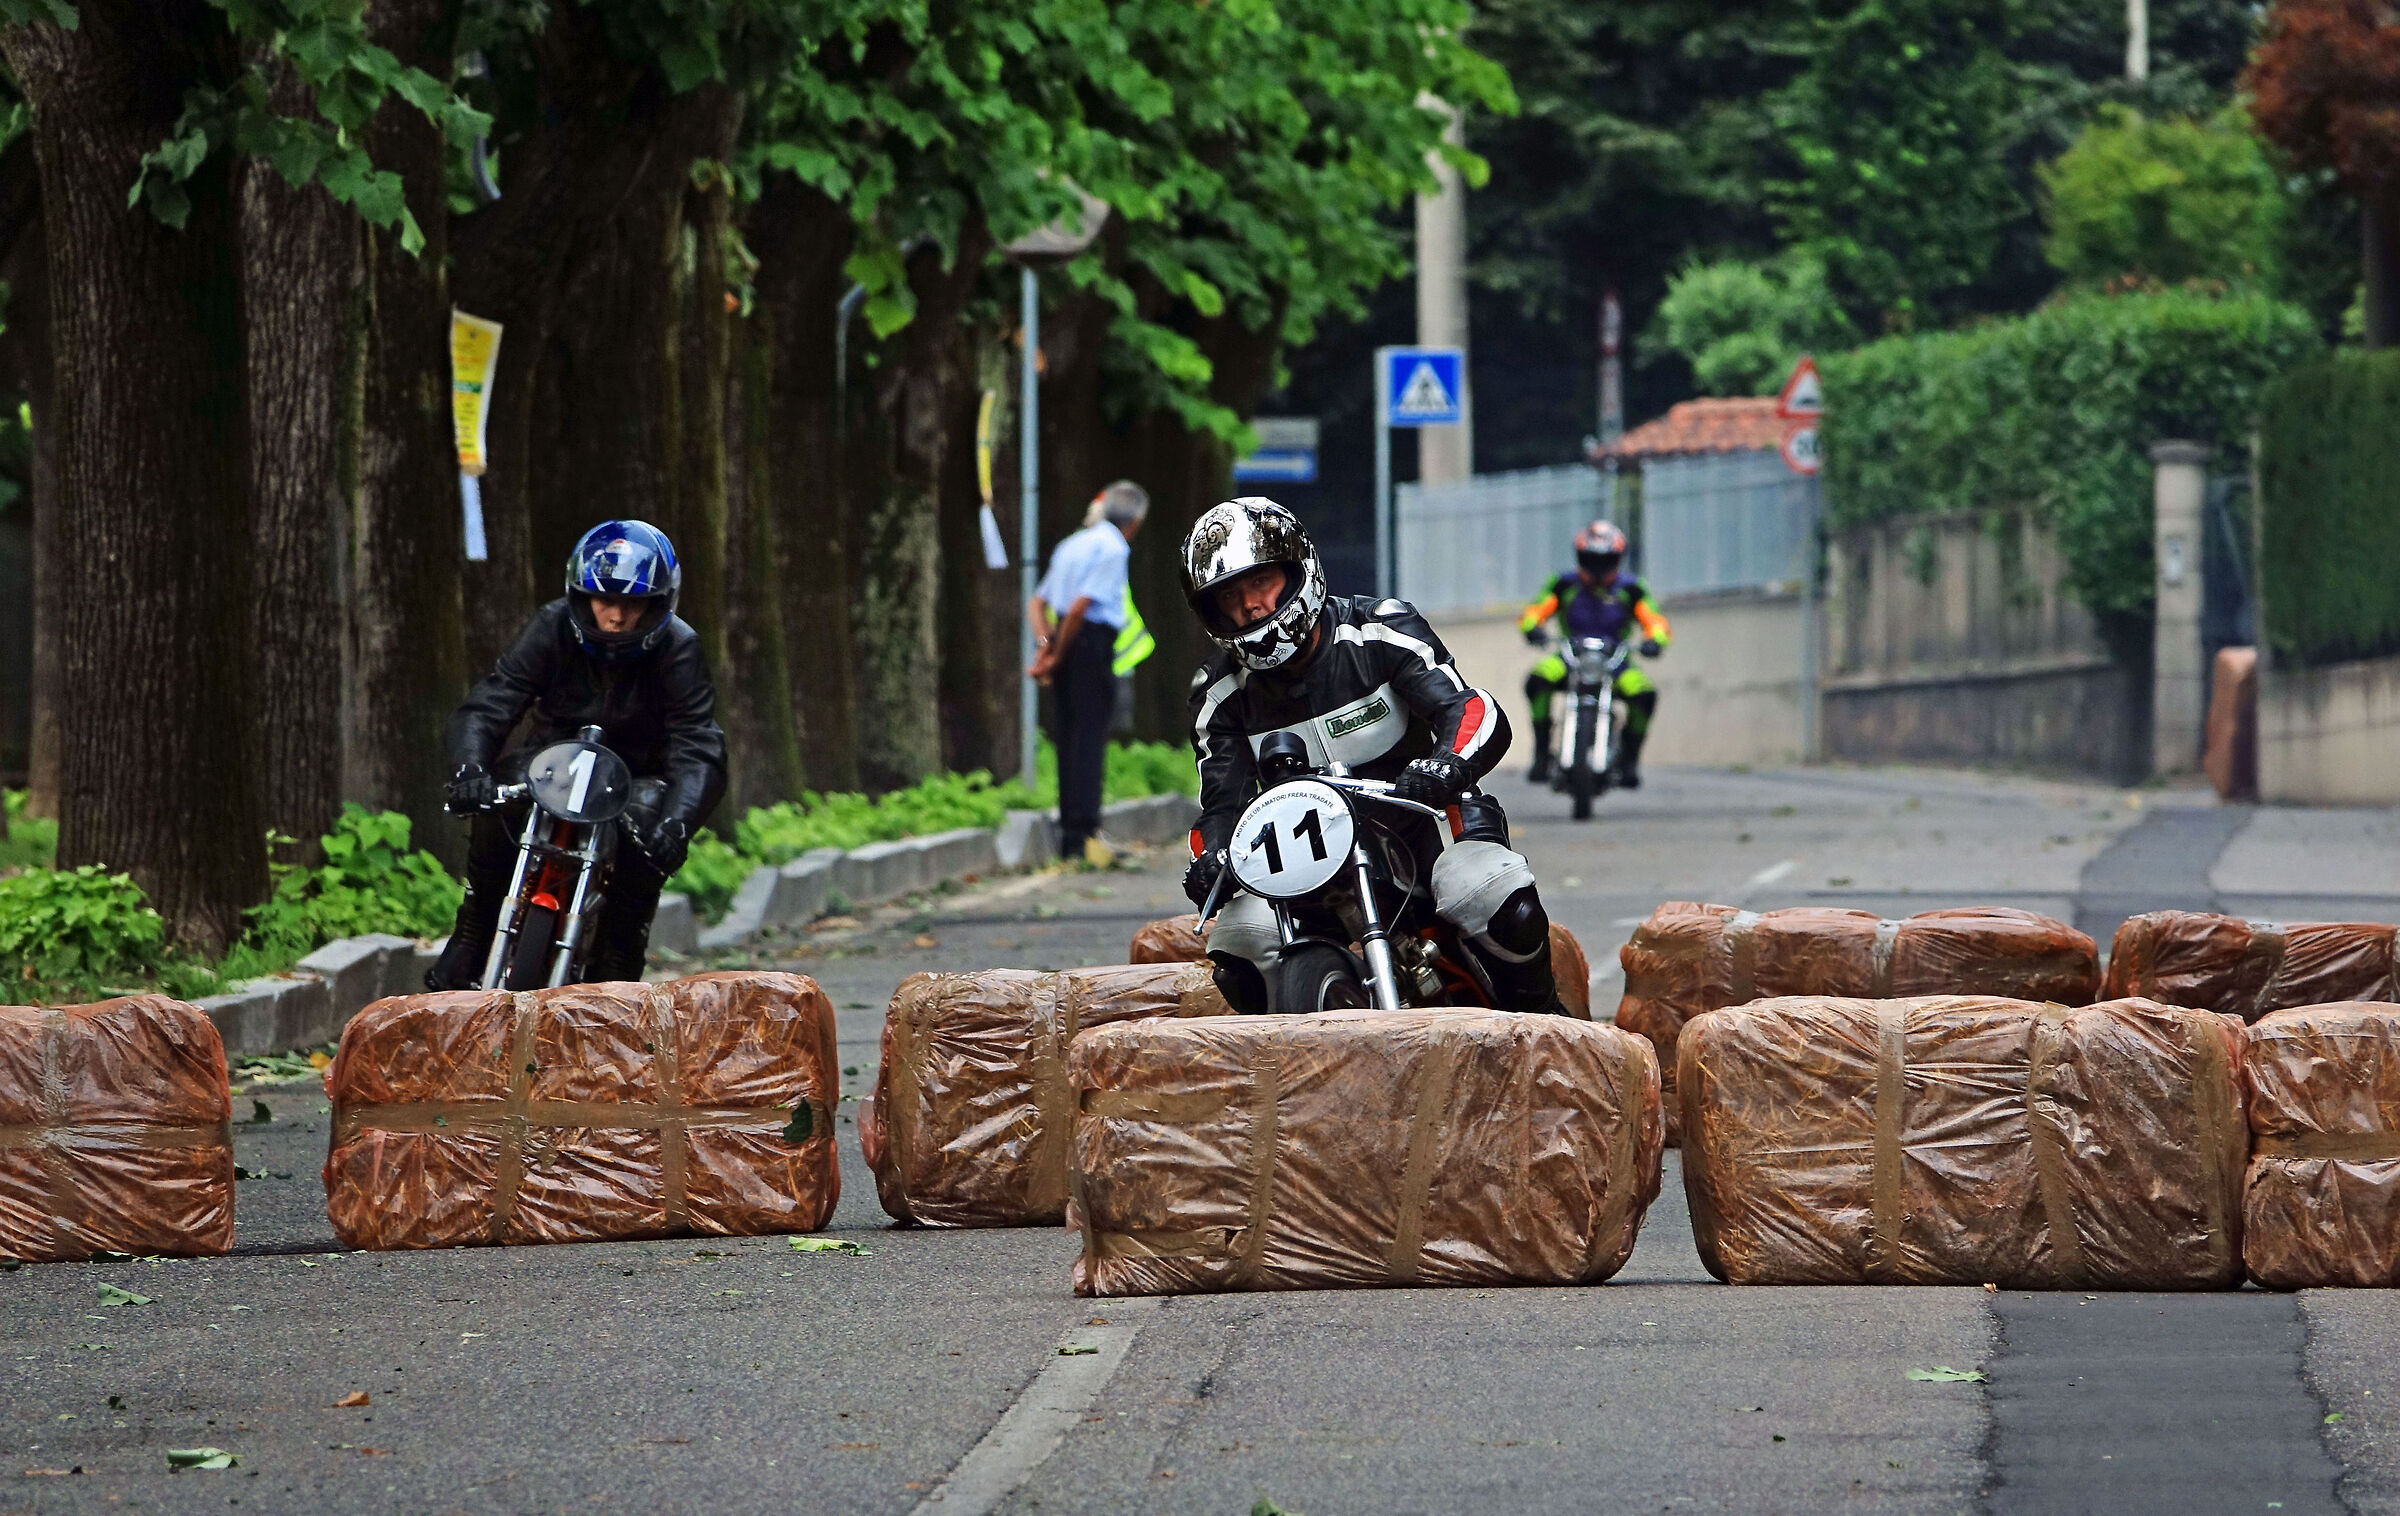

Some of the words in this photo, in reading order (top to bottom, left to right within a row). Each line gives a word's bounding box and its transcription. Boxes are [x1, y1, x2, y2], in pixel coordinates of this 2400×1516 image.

[567, 749, 597, 813] 1
[1235, 820, 1247, 838] MOTO
[1246, 806, 1261, 821] CLUB
[1261, 794, 1287, 809] AMATORI
[1287, 791, 1308, 799] FRERA
[1250, 808, 1328, 875] 11
